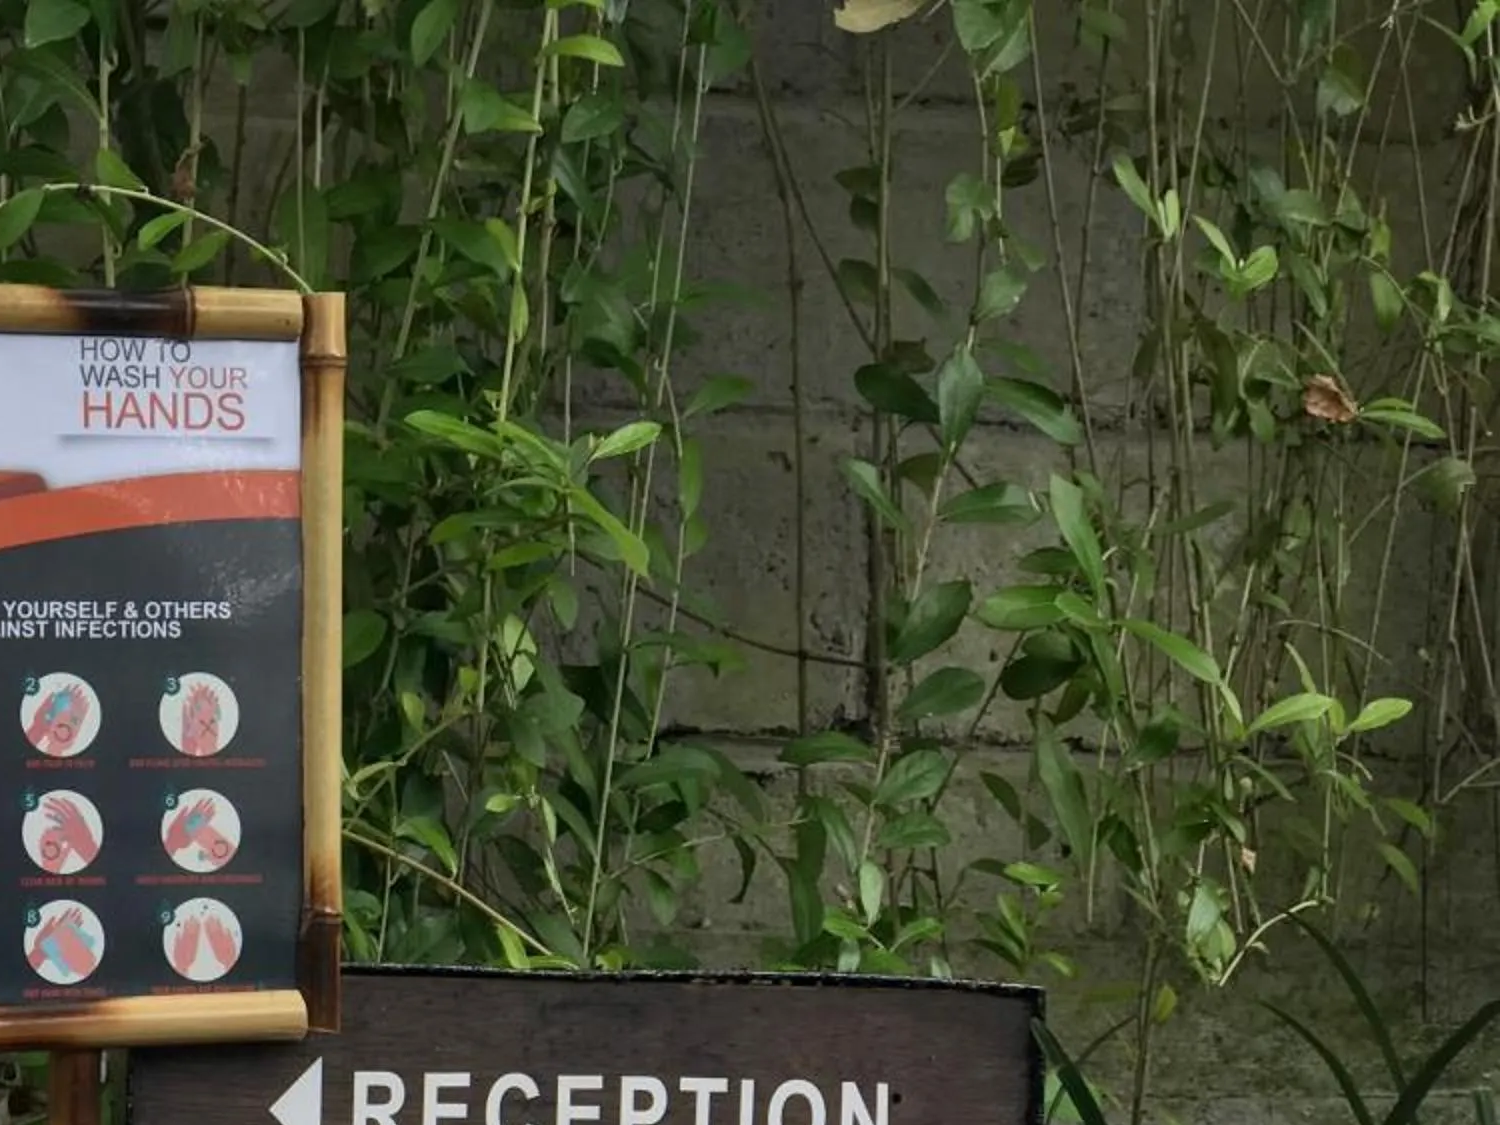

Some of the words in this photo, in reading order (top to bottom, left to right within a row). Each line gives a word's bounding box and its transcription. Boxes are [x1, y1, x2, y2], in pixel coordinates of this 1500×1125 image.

[79, 338, 147, 362] HOW
[159, 339, 192, 363] TO
[79, 364, 161, 388] WASH
[168, 366, 248, 390] YOUR
[82, 391, 246, 431] HANDS
[3, 601, 118, 619] YOURSELF
[123, 601, 139, 619] &
[144, 601, 232, 619] OTHERS
[54, 620, 182, 639] INFECTIONS
[25, 677, 37, 692] 2
[166, 677, 177, 692] 3
[25, 793, 35, 807] 5
[165, 793, 175, 807] 6
[27, 910, 37, 924] 8
[160, 911, 171, 923] 9
